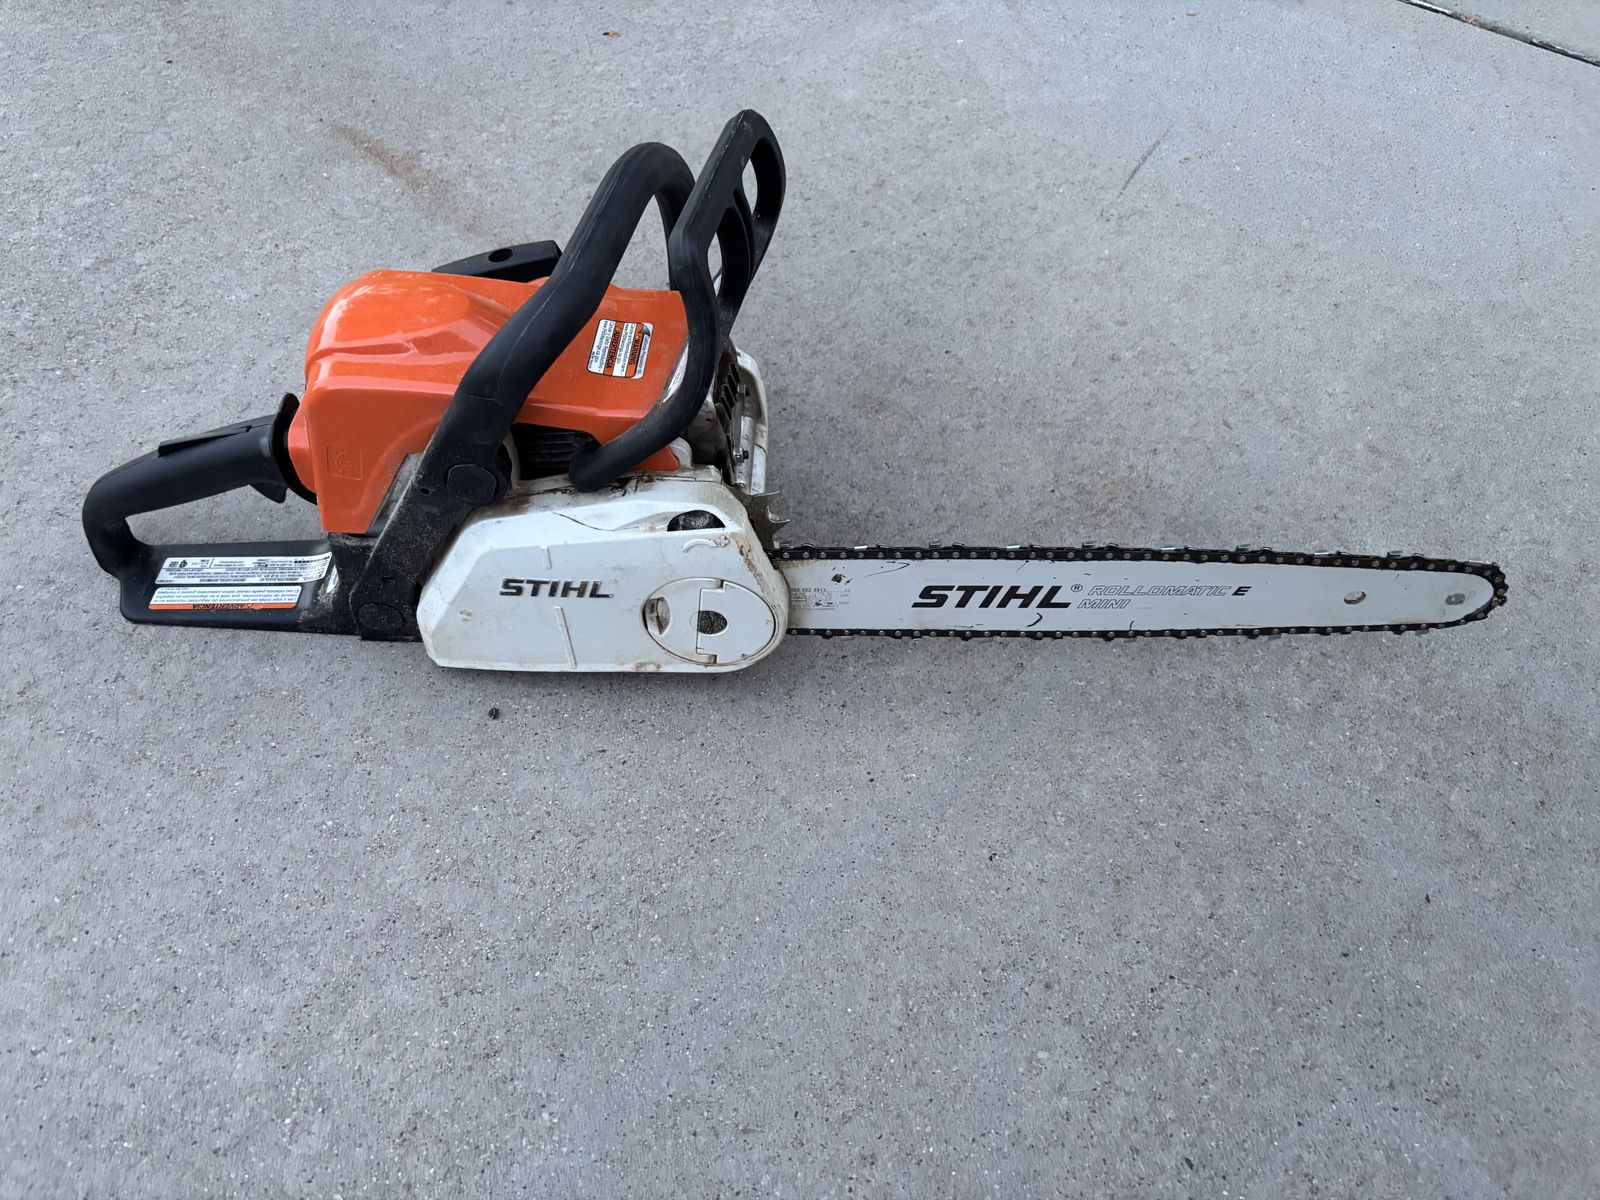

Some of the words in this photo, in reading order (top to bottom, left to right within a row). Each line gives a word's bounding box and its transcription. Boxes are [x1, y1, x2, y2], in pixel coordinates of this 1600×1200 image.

[605, 330, 620, 368] ADVERTENCIA
[628, 338, 640, 365] WARNING
[499, 578, 613, 598] STIHL
[911, 585, 1071, 608] STIHL
[1088, 585, 1232, 597] ROLLOMATIC
[1232, 586, 1252, 596] E
[1077, 599, 1131, 609] MINI
